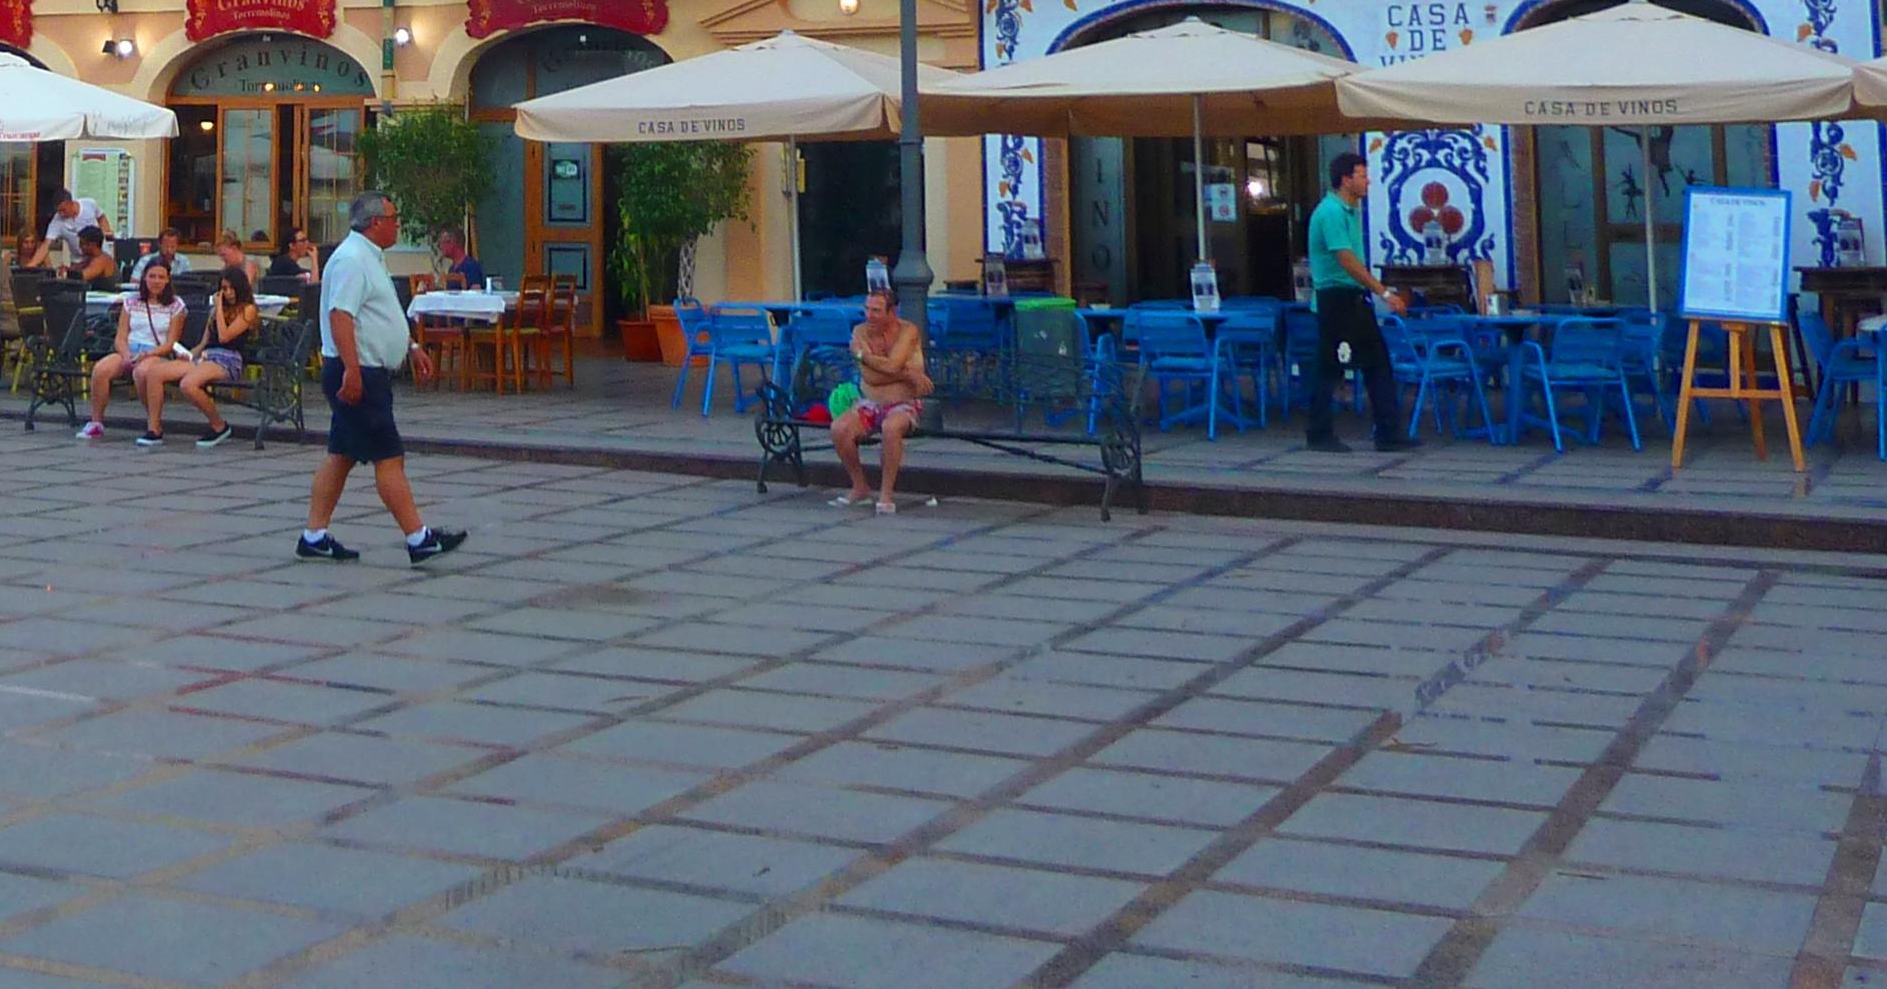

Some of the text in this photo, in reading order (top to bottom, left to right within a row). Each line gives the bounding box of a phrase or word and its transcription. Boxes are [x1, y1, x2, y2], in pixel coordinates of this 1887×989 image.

[1388, 2, 1469, 27] CASA
[1408, 29, 1446, 51] DE
[191, 43, 368, 90] Granvinos
[1525, 99, 1677, 116] CASA DE VINOS
[638, 118, 746, 134] CASA DE VINOS
